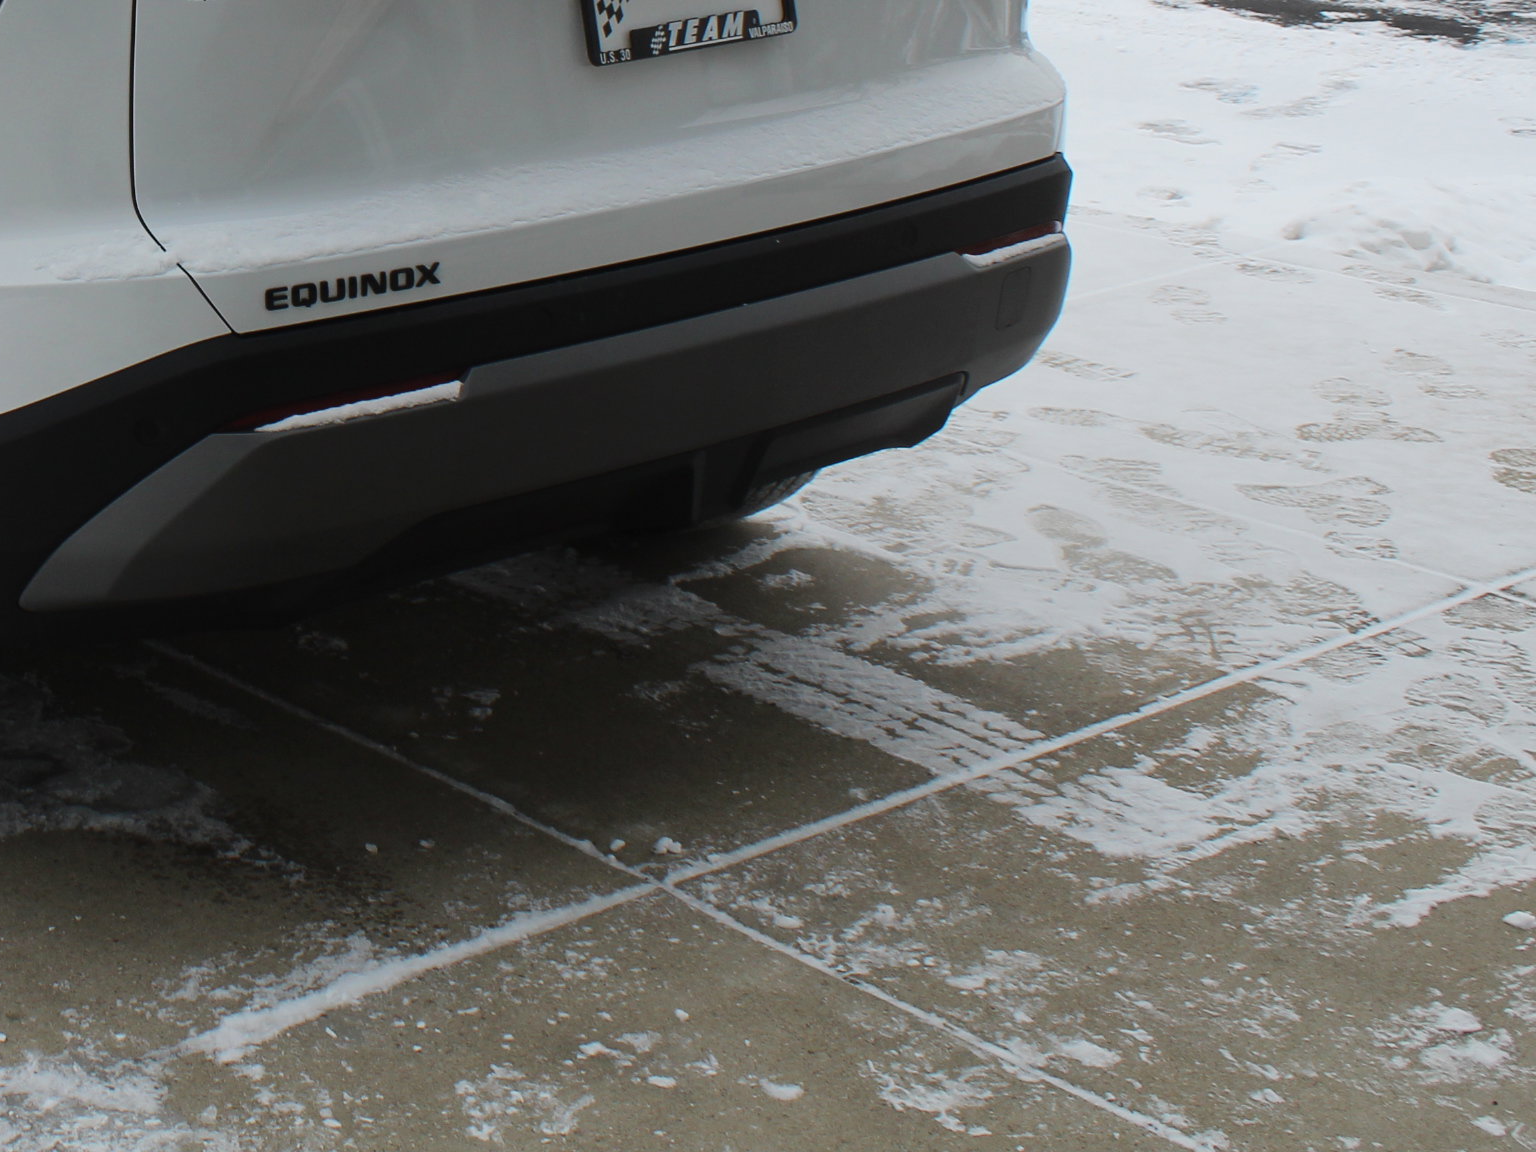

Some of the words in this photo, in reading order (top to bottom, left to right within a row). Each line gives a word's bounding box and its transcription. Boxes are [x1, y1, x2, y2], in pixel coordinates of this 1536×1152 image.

[668, 11, 744, 47] TEAM
[748, 21, 794, 40] VALPARAISO
[599, 50, 619, 65] U.S.
[620, 48, 632, 61] 30
[264, 261, 441, 312] EQUINOX
